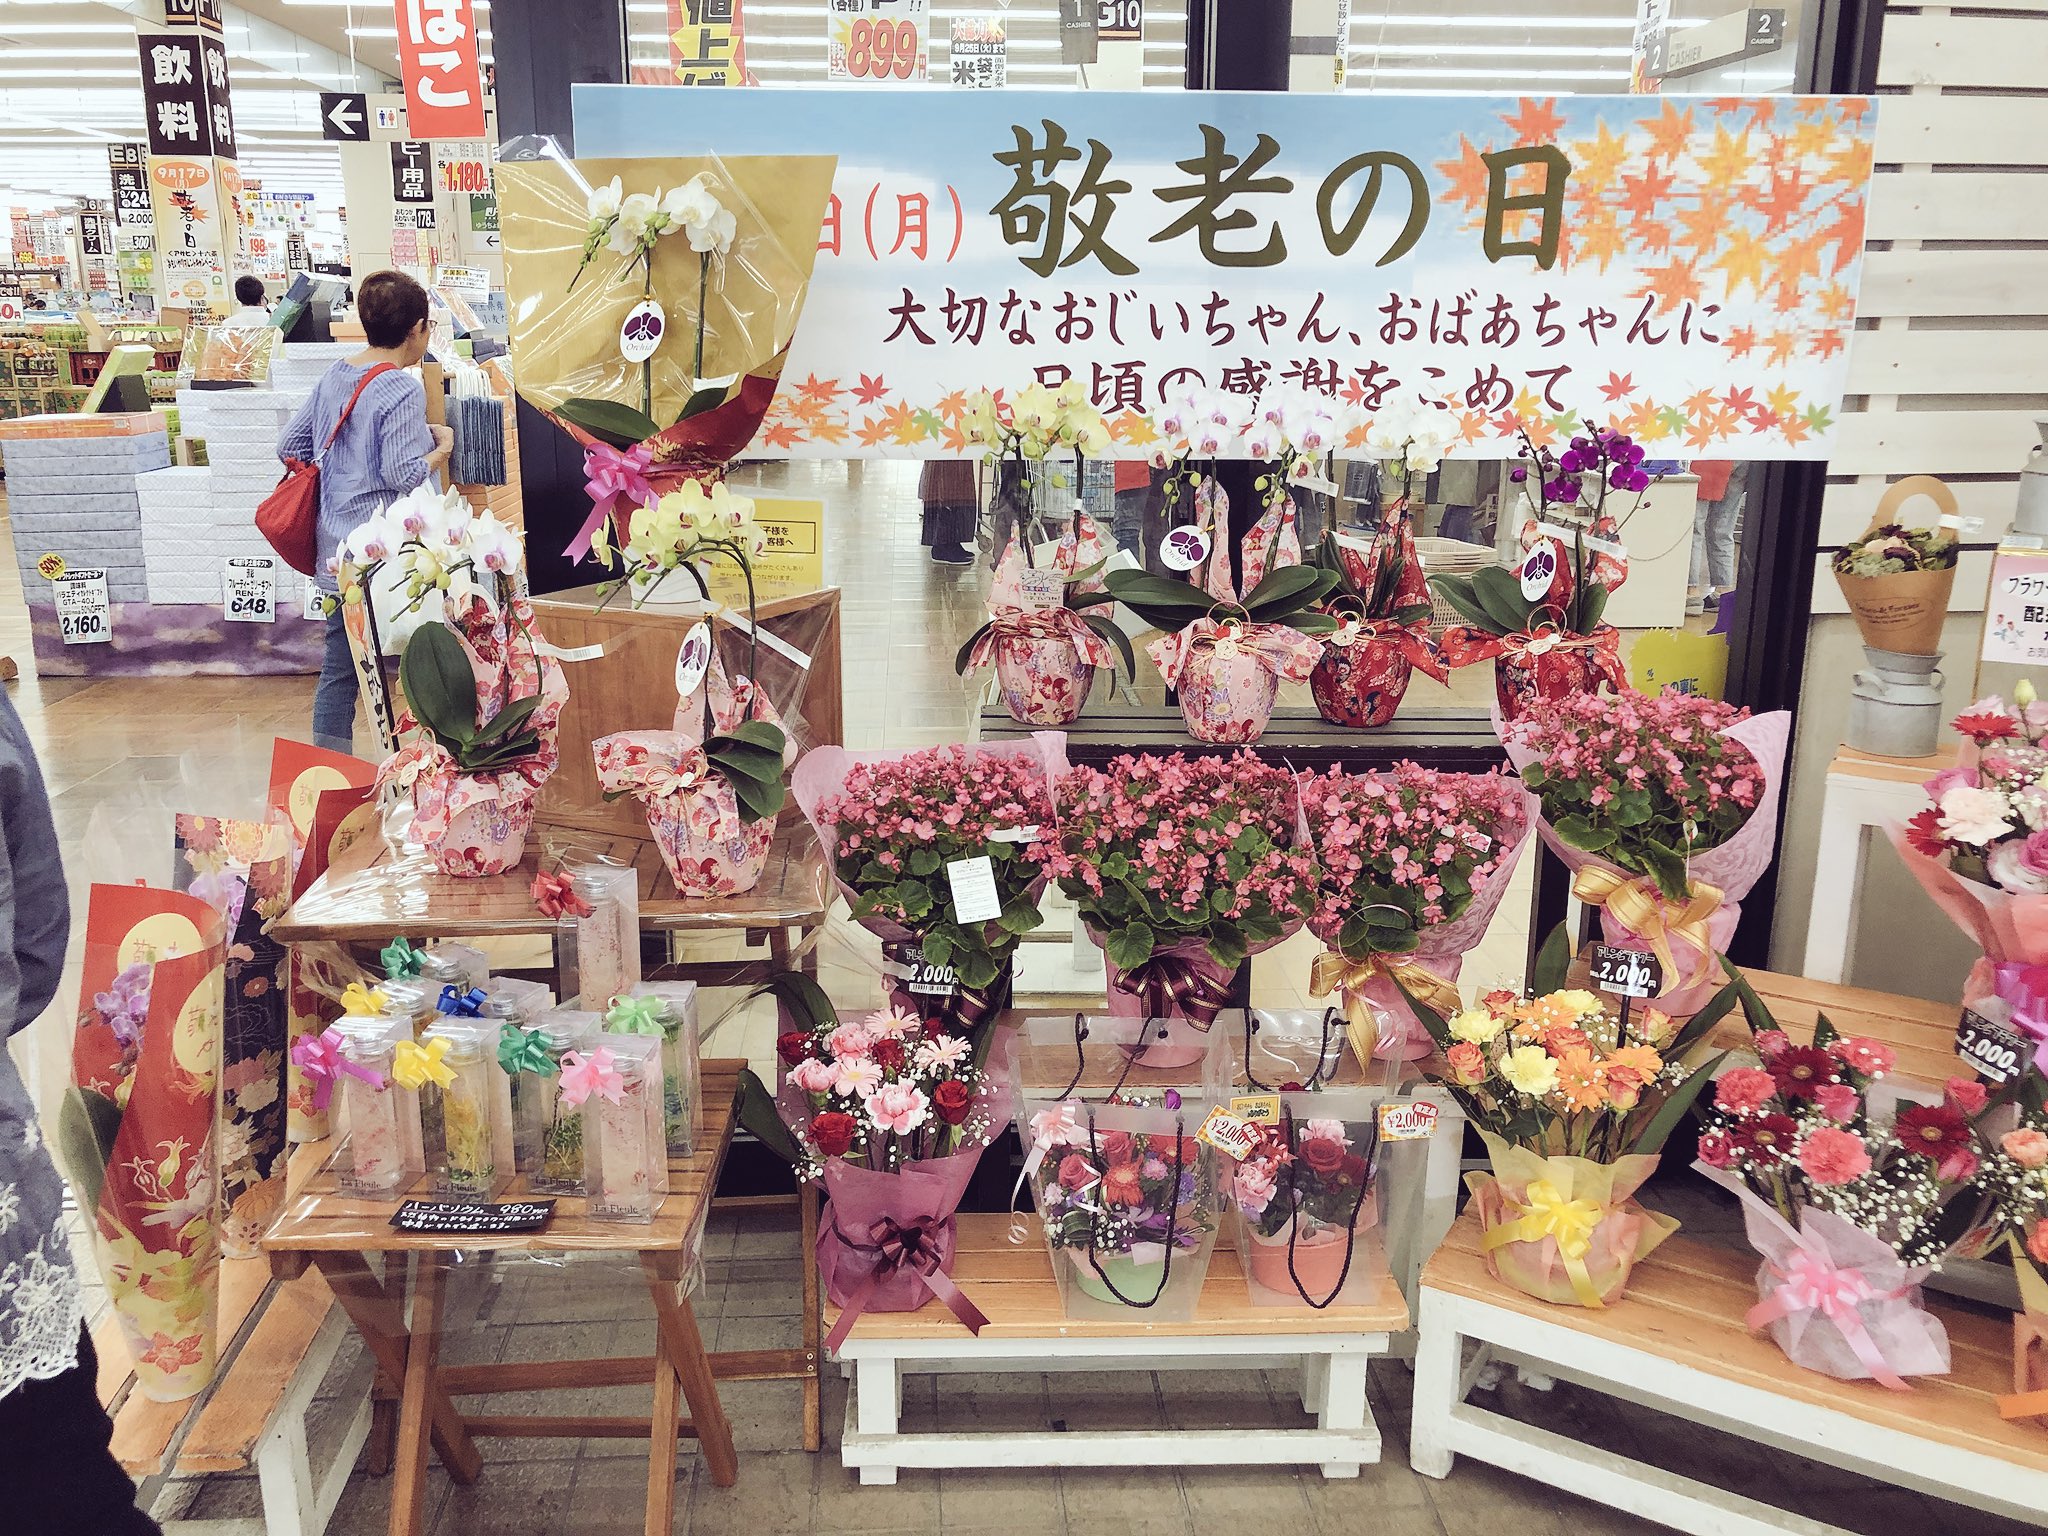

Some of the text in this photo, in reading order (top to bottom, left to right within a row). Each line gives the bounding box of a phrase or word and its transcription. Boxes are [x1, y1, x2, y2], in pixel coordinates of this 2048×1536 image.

[1757, 14, 1772, 33] 2
[848, 19, 927, 79] 899円
[1652, 45, 1662, 70] 2
[1669, 46, 1702, 67] CASHIER
[150, 44, 198, 141] 飲料
[206, 47, 232, 145] 飲料
[157, 167, 207, 179] 9月17日
[989, 119, 1572, 278] 敬老の日
[883, 287, 1721, 348] 大切なおじいちゃん、おばあちゃんに
[626, 343, 653, 351] Orchid
[2008, 577, 2048, 596] フラワ
